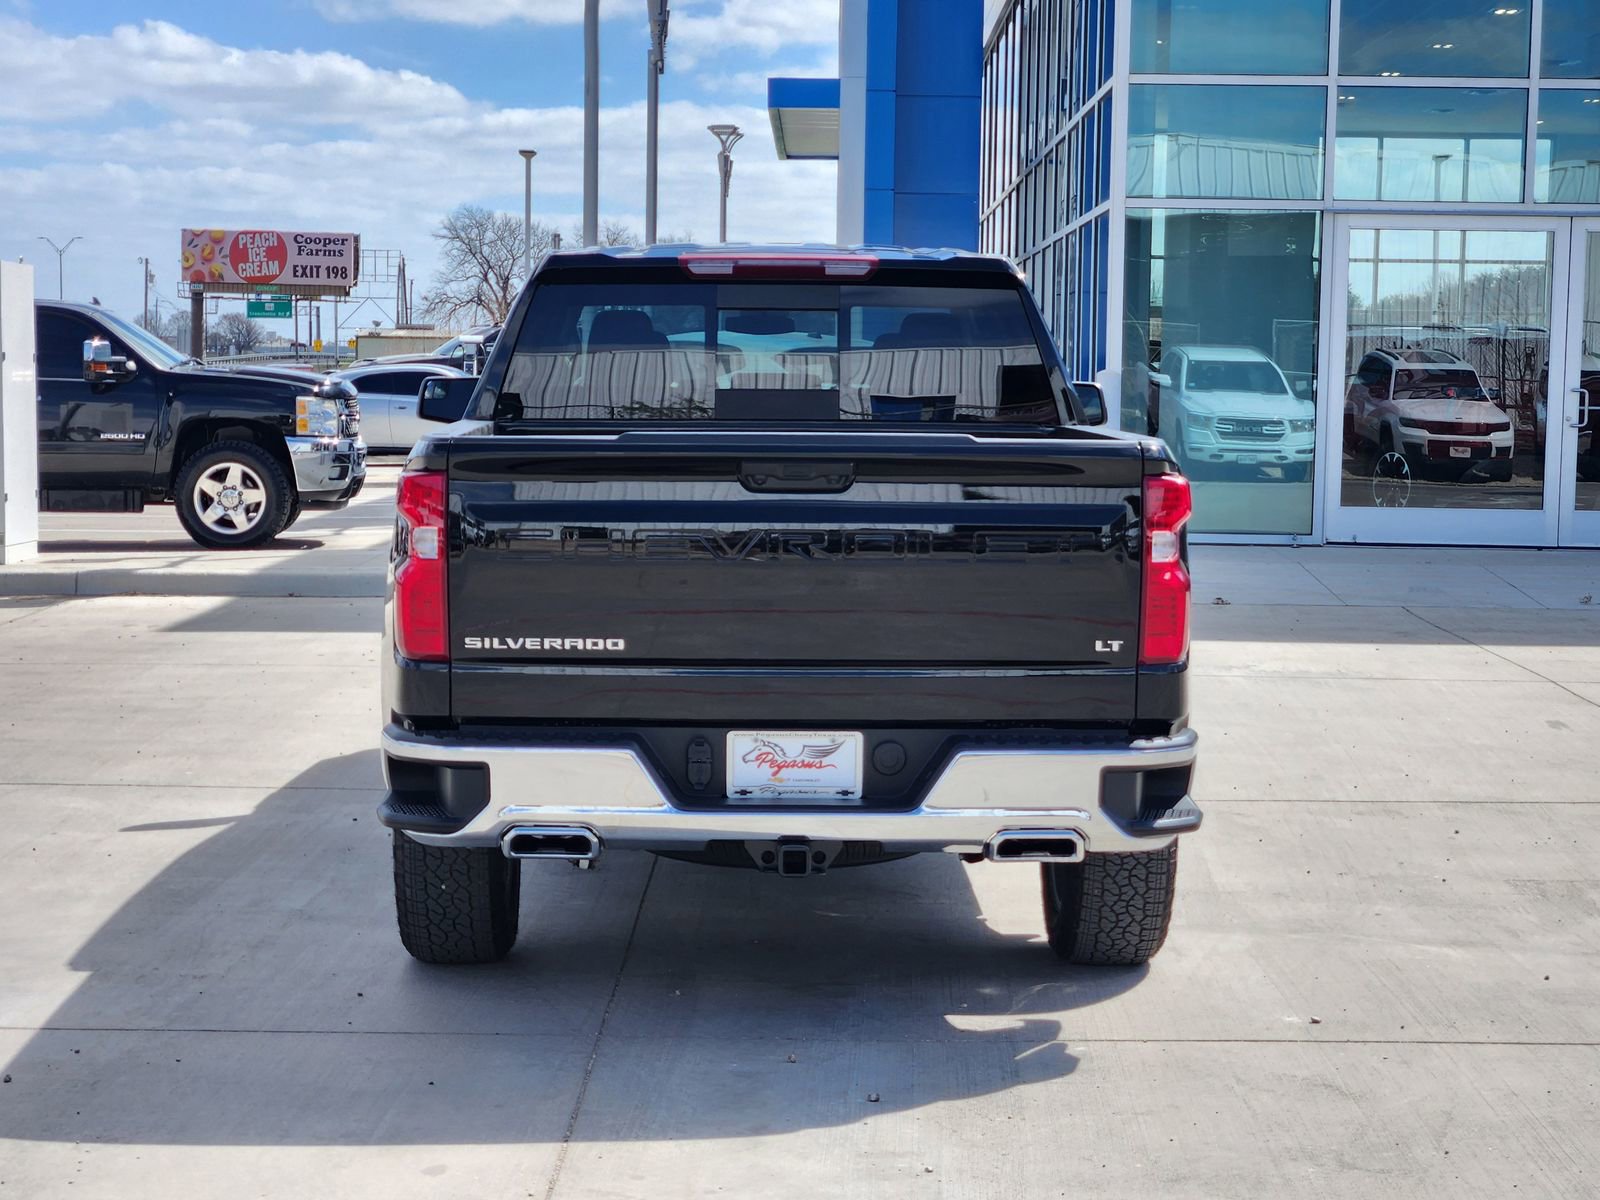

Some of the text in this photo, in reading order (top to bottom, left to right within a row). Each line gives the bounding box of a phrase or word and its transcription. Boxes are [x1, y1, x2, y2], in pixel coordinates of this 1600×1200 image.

[238, 232, 278, 248] PEACH
[293, 234, 349, 247] Cooper
[248, 248, 267, 262] ICE
[296, 245, 344, 257] Farms
[238, 261, 279, 277] CREAM
[293, 265, 348, 280] EXIT 198
[464, 637, 625, 651] SILVERADO
[1095, 640, 1124, 652] LT
[755, 752, 838, 777] Pegasus
